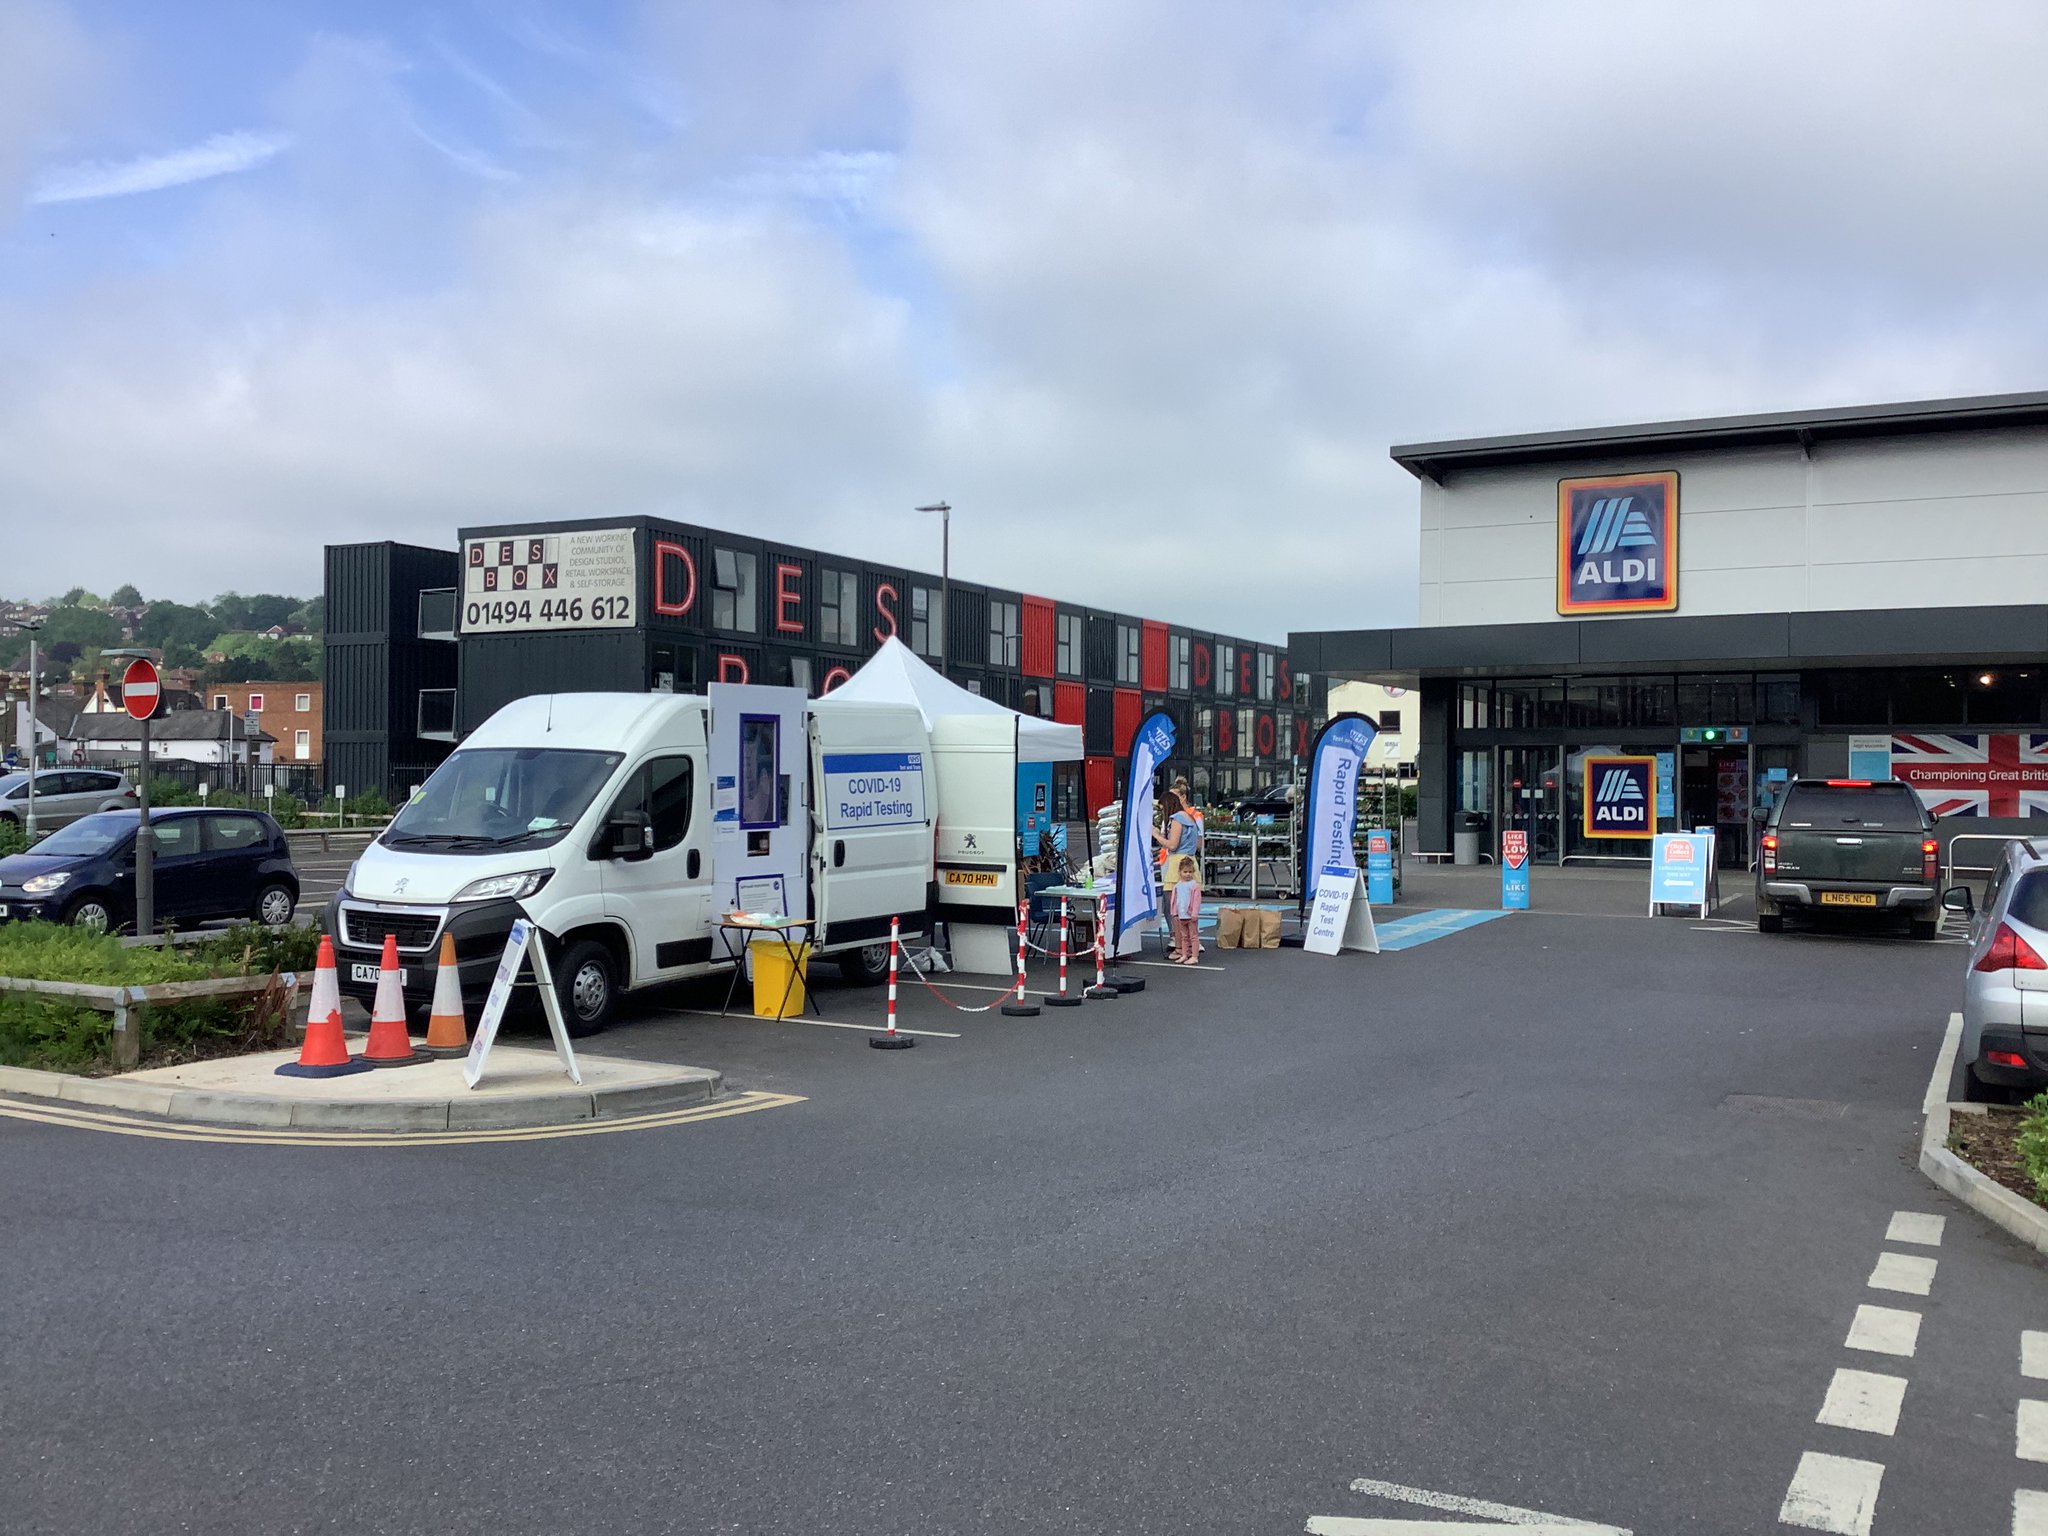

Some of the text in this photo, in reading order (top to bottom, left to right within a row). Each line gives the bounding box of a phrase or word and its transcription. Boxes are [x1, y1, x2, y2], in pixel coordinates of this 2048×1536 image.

[577, 536, 593, 544] NEW
[595, 534, 628, 543] WORKING
[571, 545, 625, 555] COMMUNITY OF
[570, 556, 627, 567] DESIGN STUDIOS,
[565, 567, 631, 578] RETAIL WORKSPACE
[1577, 558, 1656, 585] ALDI
[576, 578, 625, 588] SELF-STORAGE
[467, 596, 630, 625] 01494 446 612
[908, 755, 920, 763] NHS
[1333, 758, 1352, 804] Rapid
[1910, 769, 1986, 783] Championing
[1988, 769, 2019, 780] Great
[848, 777, 901, 794] COVID-19
[840, 800, 913, 821] Rapid Testing
[1596, 806, 1644, 821] ALDI
[1505, 845, 1527, 853] LOW
[949, 873, 994, 884] CA70 HPN
[1318, 888, 1349, 900] COVID-19
[1320, 902, 1340, 913] Rapid
[1320, 914, 1334, 925] Test
[1313, 926, 1335, 938] Centre
[356, 966, 380, 980] CA70
